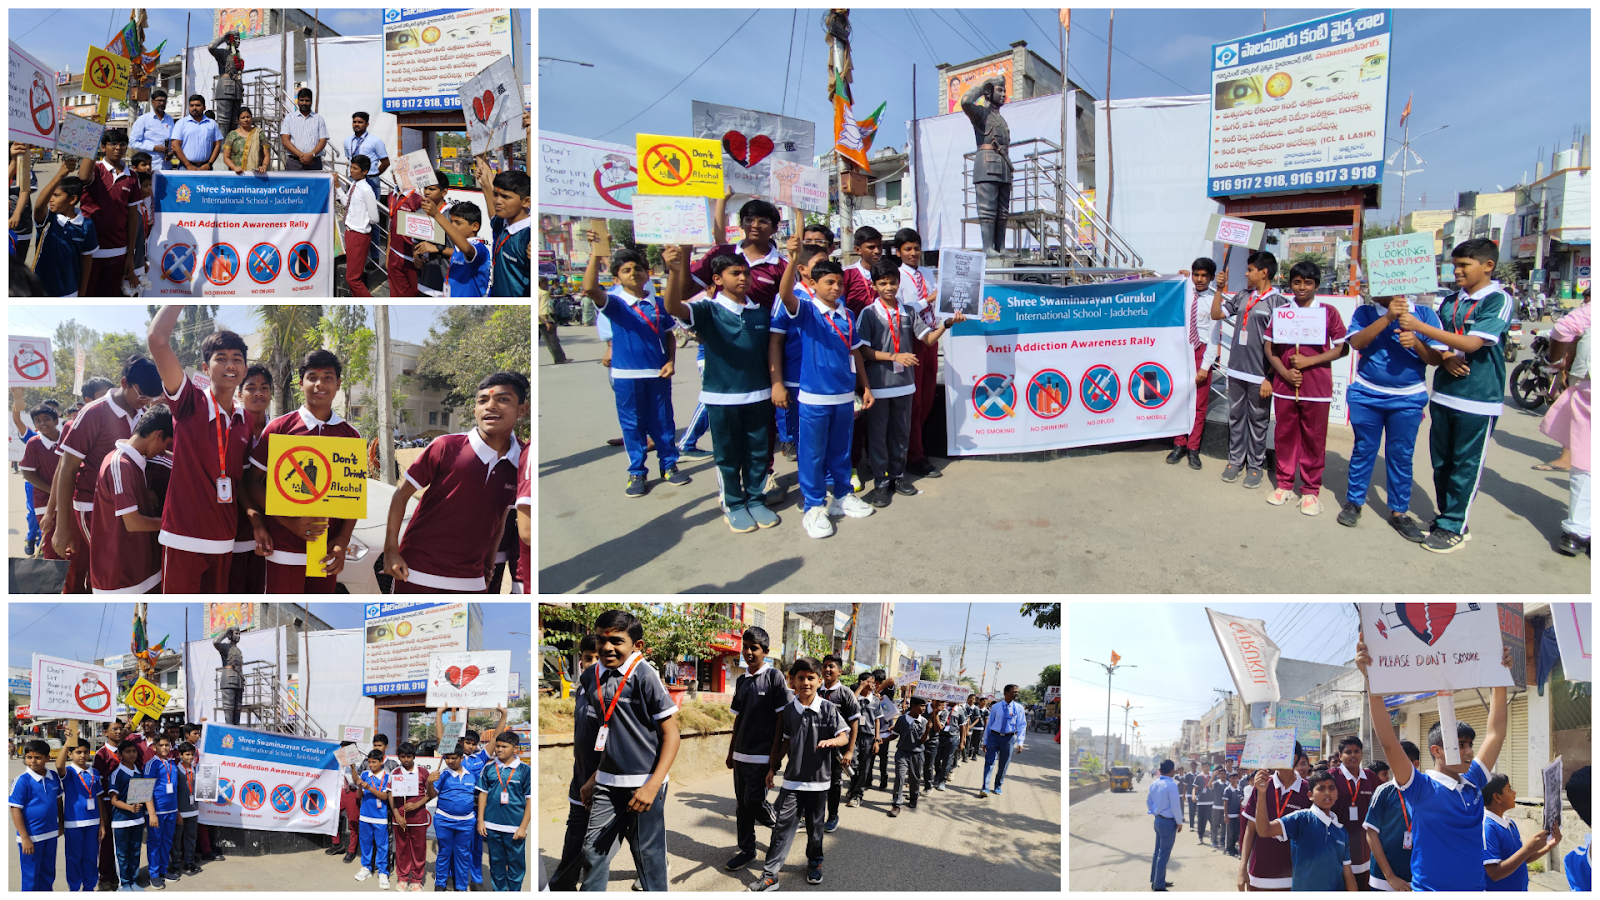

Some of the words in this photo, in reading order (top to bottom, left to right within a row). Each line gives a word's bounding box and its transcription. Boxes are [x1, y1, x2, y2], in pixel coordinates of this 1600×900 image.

[1241, 32, 1297, 58] పాలమూరు
[1300, 23, 1328, 44] కంటి
[386, 100, 400, 108] 916
[402, 99, 416, 108] 917
[417, 98, 422, 107] 2
[424, 98, 442, 107] 918,
[444, 97, 461, 106] 916
[1281, 101, 1298, 110] కంటి
[1221, 147, 1236, 155] కంటి
[1320, 136, 1336, 144] (ICL
[1347, 130, 1376, 139] LASIK)
[1222, 135, 1236, 143] కంటి
[692, 149, 714, 159] Don't
[702, 160, 722, 170] Drink
[1215, 161, 1229, 169] కంటి
[692, 170, 719, 180] Alcohol
[1212, 180, 1231, 191] 916
[1234, 179, 1254, 190] 917
[1255, 177, 1261, 188] 2
[1264, 175, 1288, 188] 918,
[1290, 173, 1313, 185] 916
[1315, 170, 1337, 183] 917
[1339, 169, 1348, 181] 3
[1351, 165, 1377, 179] 918
[196, 185, 219, 194] Shree
[221, 185, 277, 196] Swaminarayan
[278, 186, 309, 195] Gurukul
[794, 185, 802, 193] TO
[803, 187, 827, 199] TOBACCO
[202, 196, 245, 204] International
[246, 196, 269, 204] School
[274, 196, 304, 205] Jadcherla
[800, 202, 808, 210] TO
[808, 203, 819, 211] LIFE
[177, 220, 196, 228] Anti
[198, 220, 240, 228] Addiction
[242, 220, 287, 228] Awareness
[289, 220, 309, 229] Rally
[636, 212, 707, 228] DRUGS
[1384, 240, 1409, 250] STOP
[1378, 246, 1427, 258] LOOKING
[1370, 259, 1381, 268] AT
[1382, 257, 1405, 267] YOUR
[1405, 254, 1433, 266] PHONE
[1385, 270, 1407, 279] LOOK
[1380, 276, 1418, 286] AROUND
[1007, 297, 1037, 307] Shree
[1040, 295, 1112, 308] Swaminarayan
[1115, 292, 1156, 304] Gurukul
[1015, 309, 1071, 321] International
[1072, 308, 1102, 319] School
[1109, 306, 1149, 318] Jadcherla
[1278, 311, 1295, 319] NO
[986, 344, 1011, 353] Anti
[1014, 341, 1067, 352] Addiction
[1070, 337, 1127, 349] Awareness
[1129, 336, 1156, 347] Rally
[986, 427, 1015, 435] SMOKING
[1041, 423, 1068, 431] DRINKING
[332, 452, 358, 465] Don't
[343, 467, 367, 480] Drink
[330, 481, 362, 493] Alcohol
[1229, 621, 1270, 684] GURUKUL
[1379, 654, 1410, 667] PLEASE
[1416, 651, 1446, 666] DON'T
[1453, 651, 1480, 665] SMOKE
[365, 684, 378, 693] 916
[379, 684, 390, 692] 917
[412, 682, 425, 690] 916
[238, 736, 255, 745] Shree
[256, 737, 300, 752] Swaminarayan
[301, 745, 326, 755] Gurukul
[221, 760, 236, 768] Anti
[237, 762, 269, 772] Addiction
[270, 767, 305, 777] Awareness
[305, 771, 321, 780] Rally
